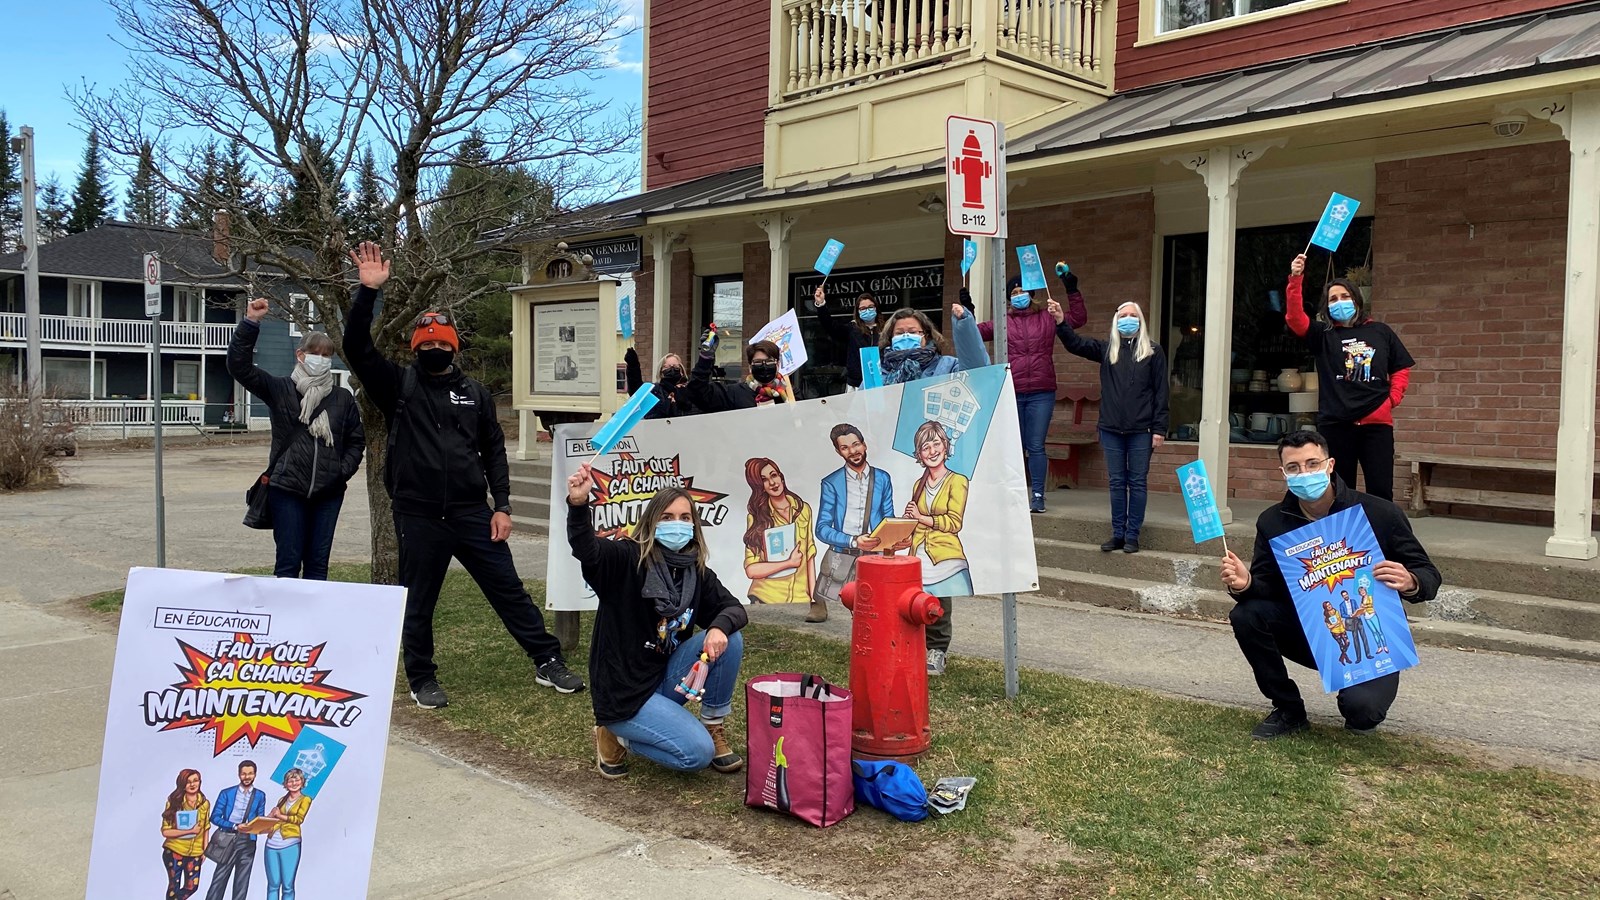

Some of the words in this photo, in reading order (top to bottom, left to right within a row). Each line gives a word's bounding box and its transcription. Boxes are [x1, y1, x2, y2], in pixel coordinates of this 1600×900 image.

[962, 214, 986, 226] B-112
[572, 443, 585, 453] EN
[613, 458, 646, 475] FAUT
[650, 458, 675, 473] QUE
[609, 479, 630, 499] ÇA
[633, 475, 686, 493] CHANGE
[1311, 546, 1328, 558] FAUT
[1330, 540, 1343, 551] QUE
[1323, 547, 1349, 563] CHANGE
[164, 613, 183, 625] EN
[187, 611, 261, 630] ÉDUCATION
[217, 641, 270, 661] FAUT
[273, 644, 314, 663] QUE
[205, 662, 235, 683] ÇA
[239, 663, 318, 684] CHANGE
